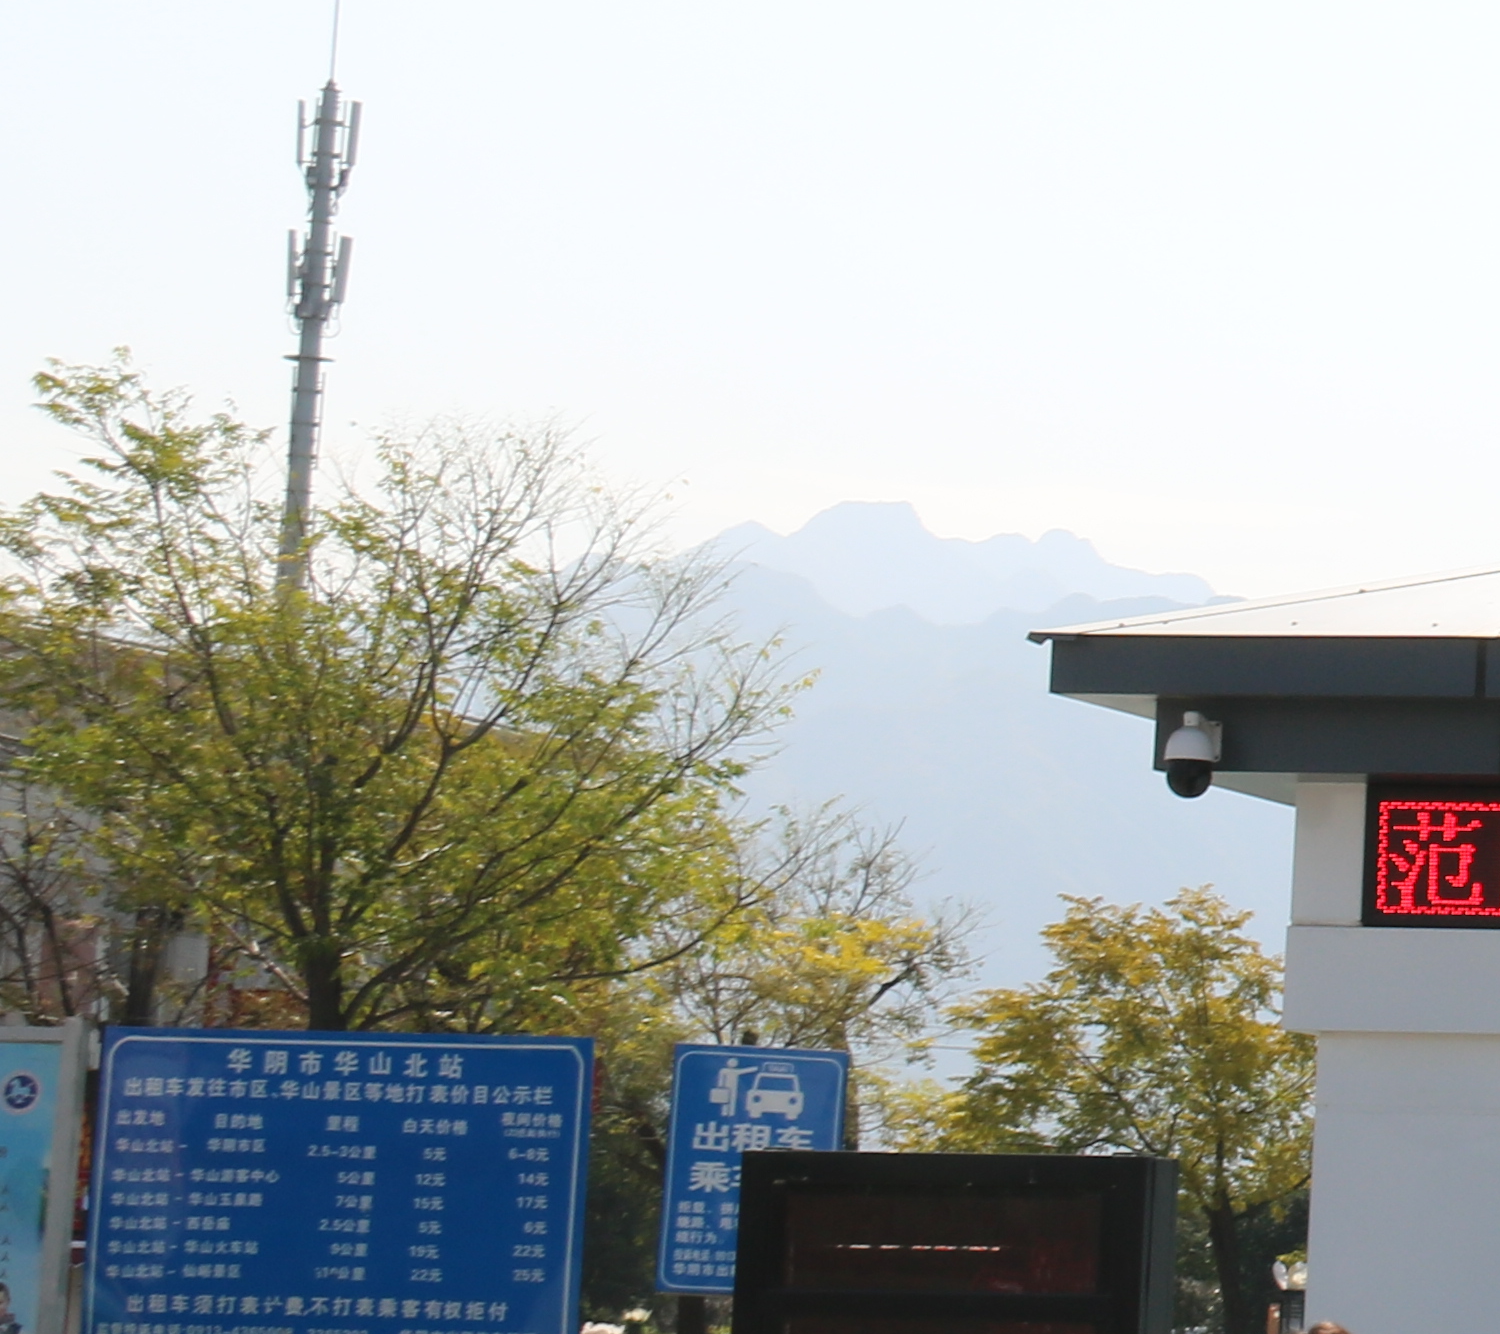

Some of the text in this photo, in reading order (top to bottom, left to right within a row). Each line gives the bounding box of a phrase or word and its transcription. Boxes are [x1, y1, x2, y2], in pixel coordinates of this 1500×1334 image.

[227, 1047, 464, 1080] 华阴市华山北站
[115, 1109, 166, 1126] 出发地
[214, 1113, 264, 1130] 目的地
[402, 1118, 468, 1136] 白天价格
[692, 1121, 815, 1153] 出租车
[206, 1138, 266, 1153] 华阴市区
[422, 1147, 447, 1162] 5元
[337, 1171, 375, 1186] 5公里
[415, 1173, 446, 1187] 12元
[518, 1172, 549, 1187] 14元
[413, 1197, 444, 1211] 15元
[516, 1195, 548, 1210] 17元
[418, 1221, 442, 1235] 5元
[512, 1245, 546, 1259] 22元
[410, 1269, 443, 1283] 22元
[513, 1269, 546, 1283] 25元
